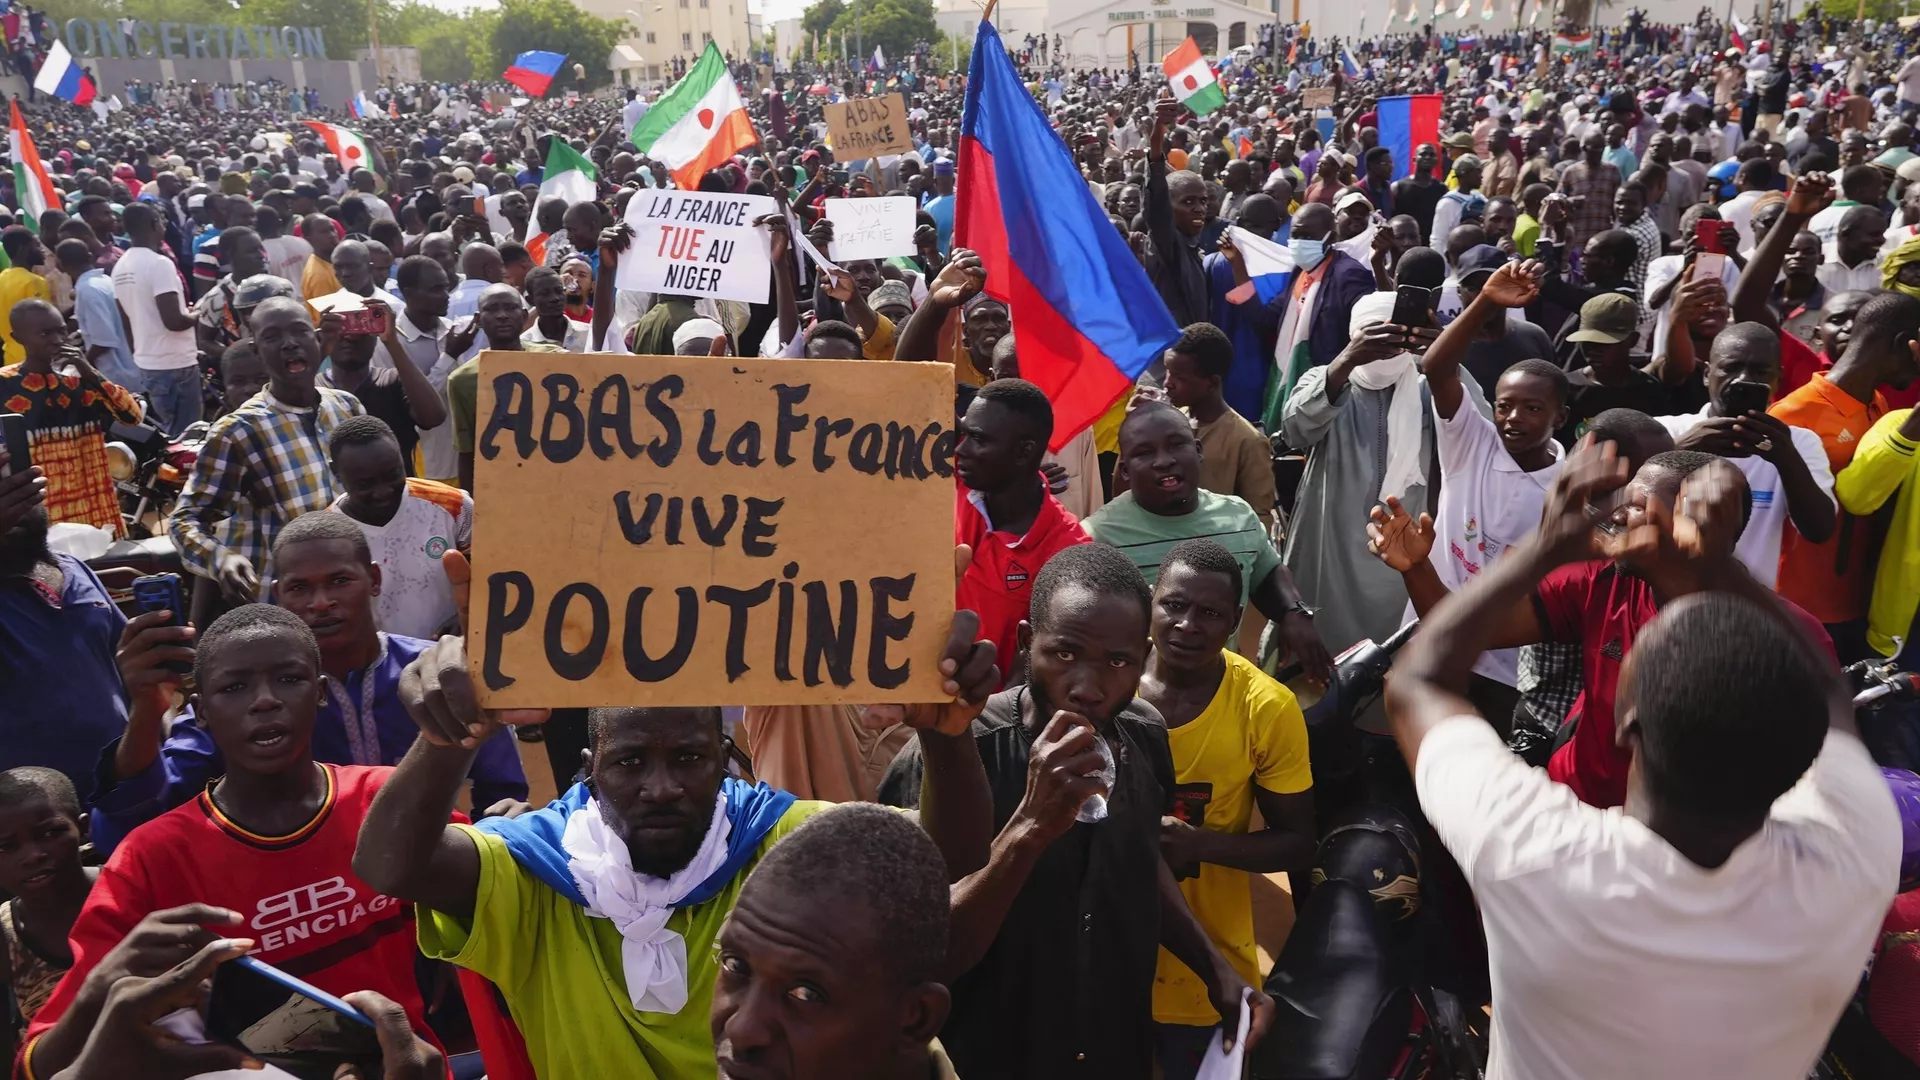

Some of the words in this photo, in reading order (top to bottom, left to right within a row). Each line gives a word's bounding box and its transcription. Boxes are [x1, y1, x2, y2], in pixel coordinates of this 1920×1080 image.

[845, 96, 889, 128] ABAS
[646, 196, 673, 218] LA
[675, 198, 750, 226] FRANCE
[847, 201, 893, 216] VIVE
[838, 227, 894, 248] PATRIE
[857, 219, 881, 231] LA
[657, 225, 705, 262] TUE
[705, 239, 735, 264] AU
[663, 264, 722, 292] NIGER
[480, 371, 685, 468] ABAS
[771, 383, 956, 481] France
[613, 490, 786, 558] VIVE
